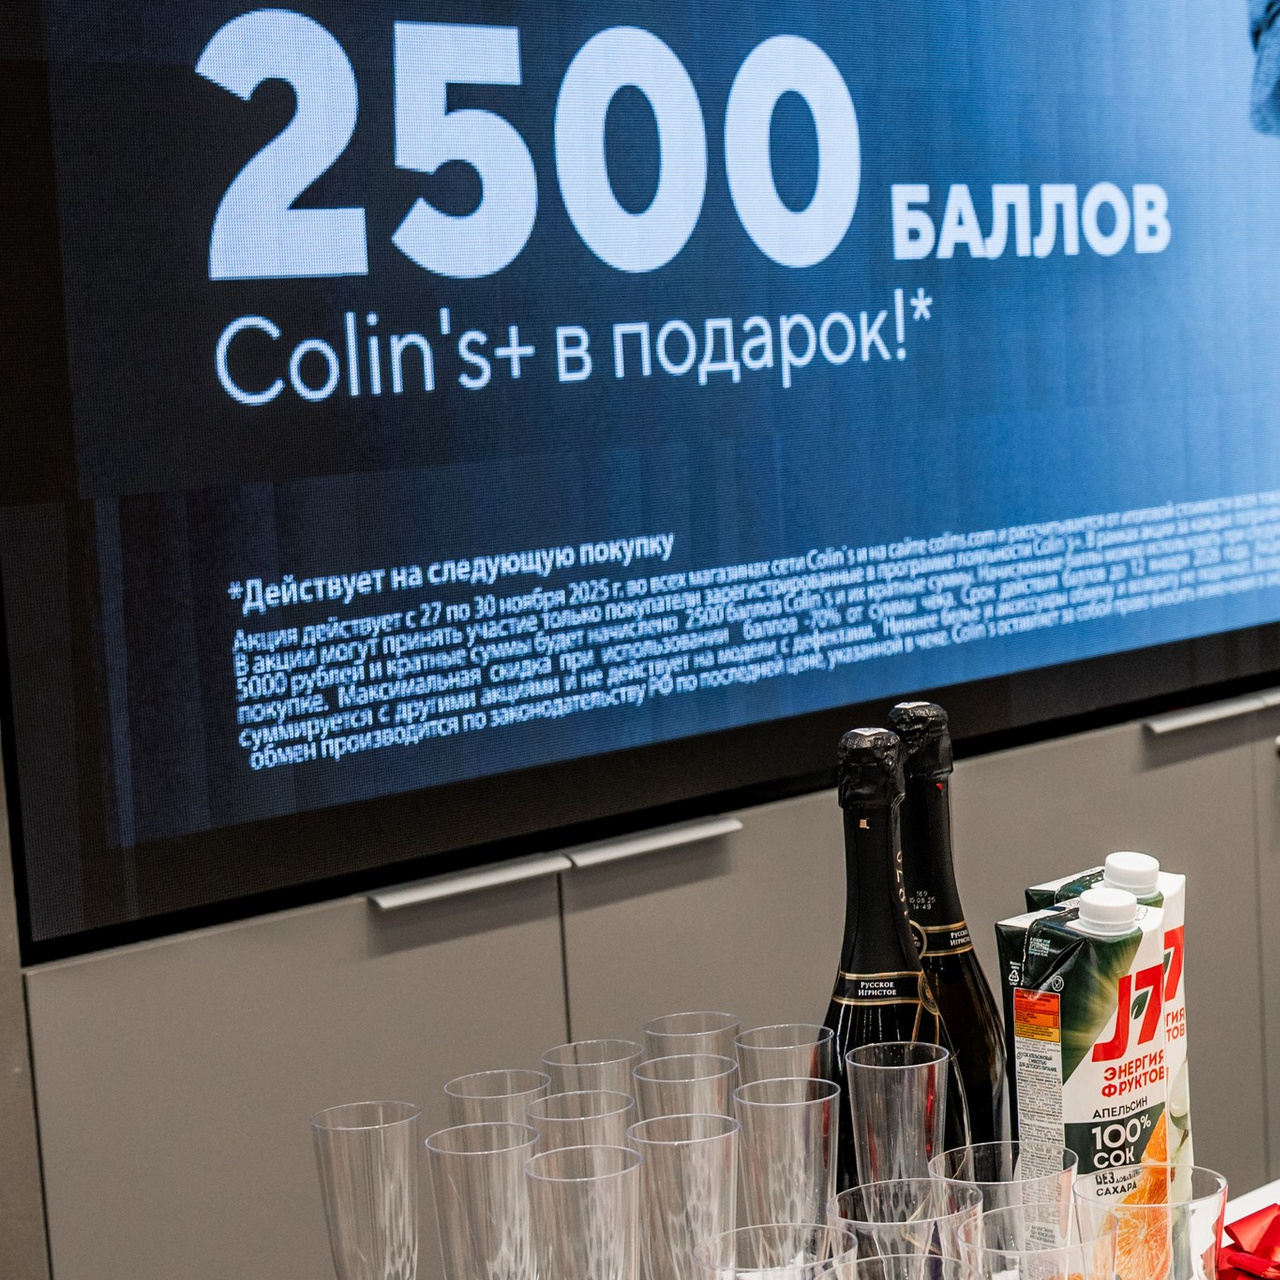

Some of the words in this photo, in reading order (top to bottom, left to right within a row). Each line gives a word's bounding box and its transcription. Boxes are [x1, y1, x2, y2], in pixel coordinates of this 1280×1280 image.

[195, 7, 862, 281] 2500
[890, 182, 1172, 261] БАЛЛОВ
[214, 310, 537, 408] Colin's+
[556, 331, 594, 383] в
[230, 627, 300, 655] Акция
[298, 613, 404, 649] действует
[418, 600, 444, 626] 27
[444, 603, 472, 623] по
[472, 593, 497, 619] 30
[498, 586, 567, 615] ноября
[567, 577, 611, 605] 2025
[611, 583, 625, 599] г.
[648, 573, 687, 594] всех
[769, 556, 807, 576] сети
[805, 544, 856, 571] Colin's
[391, 567, 424, 588] на
[428, 545, 575, 584] следующую
[579, 532, 676, 569] покупку
[233, 669, 289, 700] 5000
[288, 657, 366, 697] рублей
[384, 648, 469, 680] кратные
[468, 638, 534, 667] суммы
[532, 629, 586, 657] будет
[683, 602, 726, 630] 2500
[235, 694, 330, 724] покупке.
[335, 668, 483, 708] Максимальная
[488, 656, 553, 683] скидка
[557, 650, 595, 674] при
[600, 628, 730, 664] использовании
[741, 616, 799, 641] баллов
[959, 583, 997, 608] Срок
[250, 648, 318, 675] акции
[318, 639, 381, 664] могут
[380, 626, 465, 658] принять
[464, 615, 539, 647] участие
[539, 606, 602, 631] только
[603, 591, 703, 622] покупатели
[237, 708, 375, 751] суммируется
[393, 691, 477, 726] другими
[478, 676, 561, 707] акциями
[578, 669, 604, 689] не
[604, 655, 690, 689] действует
[691, 650, 716, 669] на
[715, 640, 778, 666] модели
[248, 741, 318, 770] обмен
[319, 716, 460, 760] производится
[460, 711, 488, 731] по
[488, 682, 648, 727] законодательству
[646, 671, 675, 698] РФ
[674, 673, 699, 693] по
[698, 652, 785, 689] последней
[1091, 962, 1165, 1063] J7
[1092, 1095, 1148, 1120] АПЕЛЬСИН
[1101, 1066, 1167, 1098] ФРУКТОВ
[1103, 1049, 1165, 1081] ЭНЕРГИЯ
[1091, 1113, 1151, 1150] 100%
[1093, 1146, 1135, 1169] СОК
[1096, 1180, 1138, 1197] САХАРА
